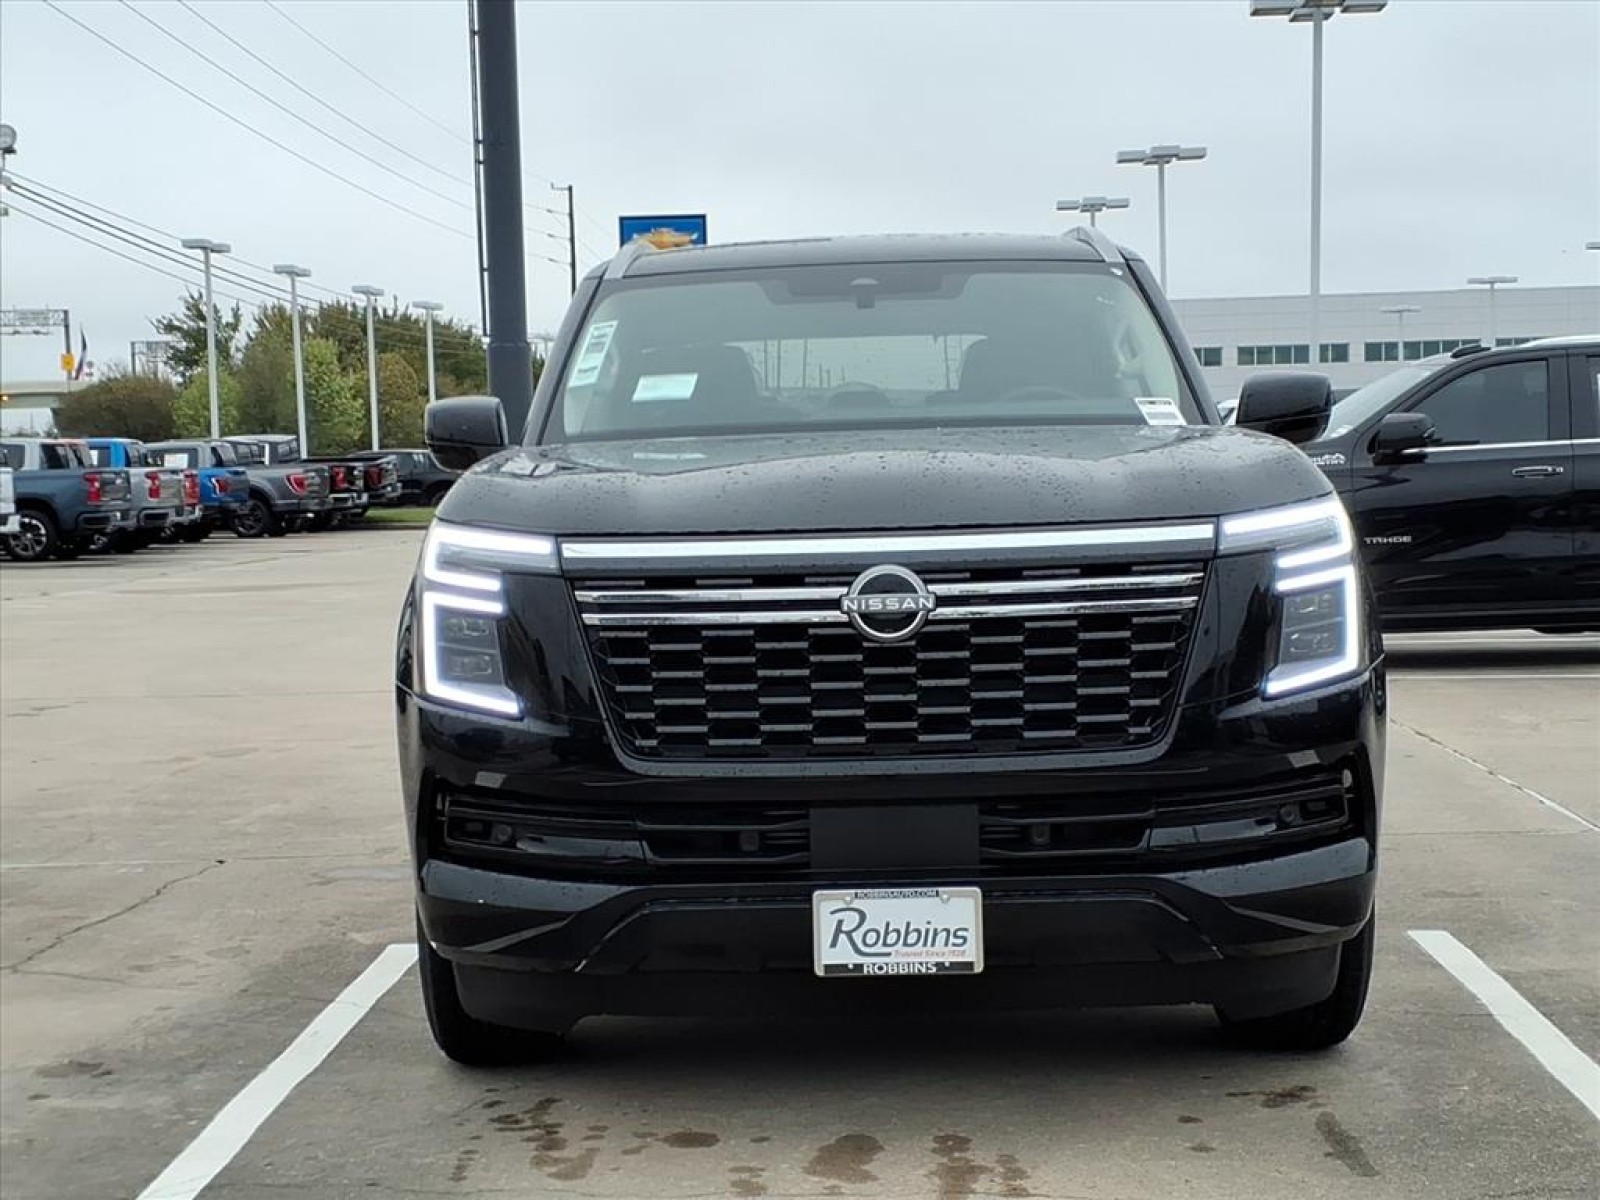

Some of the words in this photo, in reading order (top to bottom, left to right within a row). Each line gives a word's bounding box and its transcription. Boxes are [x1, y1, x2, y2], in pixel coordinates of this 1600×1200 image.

[1363, 535, 1412, 544] TAHOE
[843, 597, 933, 610] NISSAN
[829, 907, 969, 956] Robbins
[863, 961, 936, 974] ROBBINS
